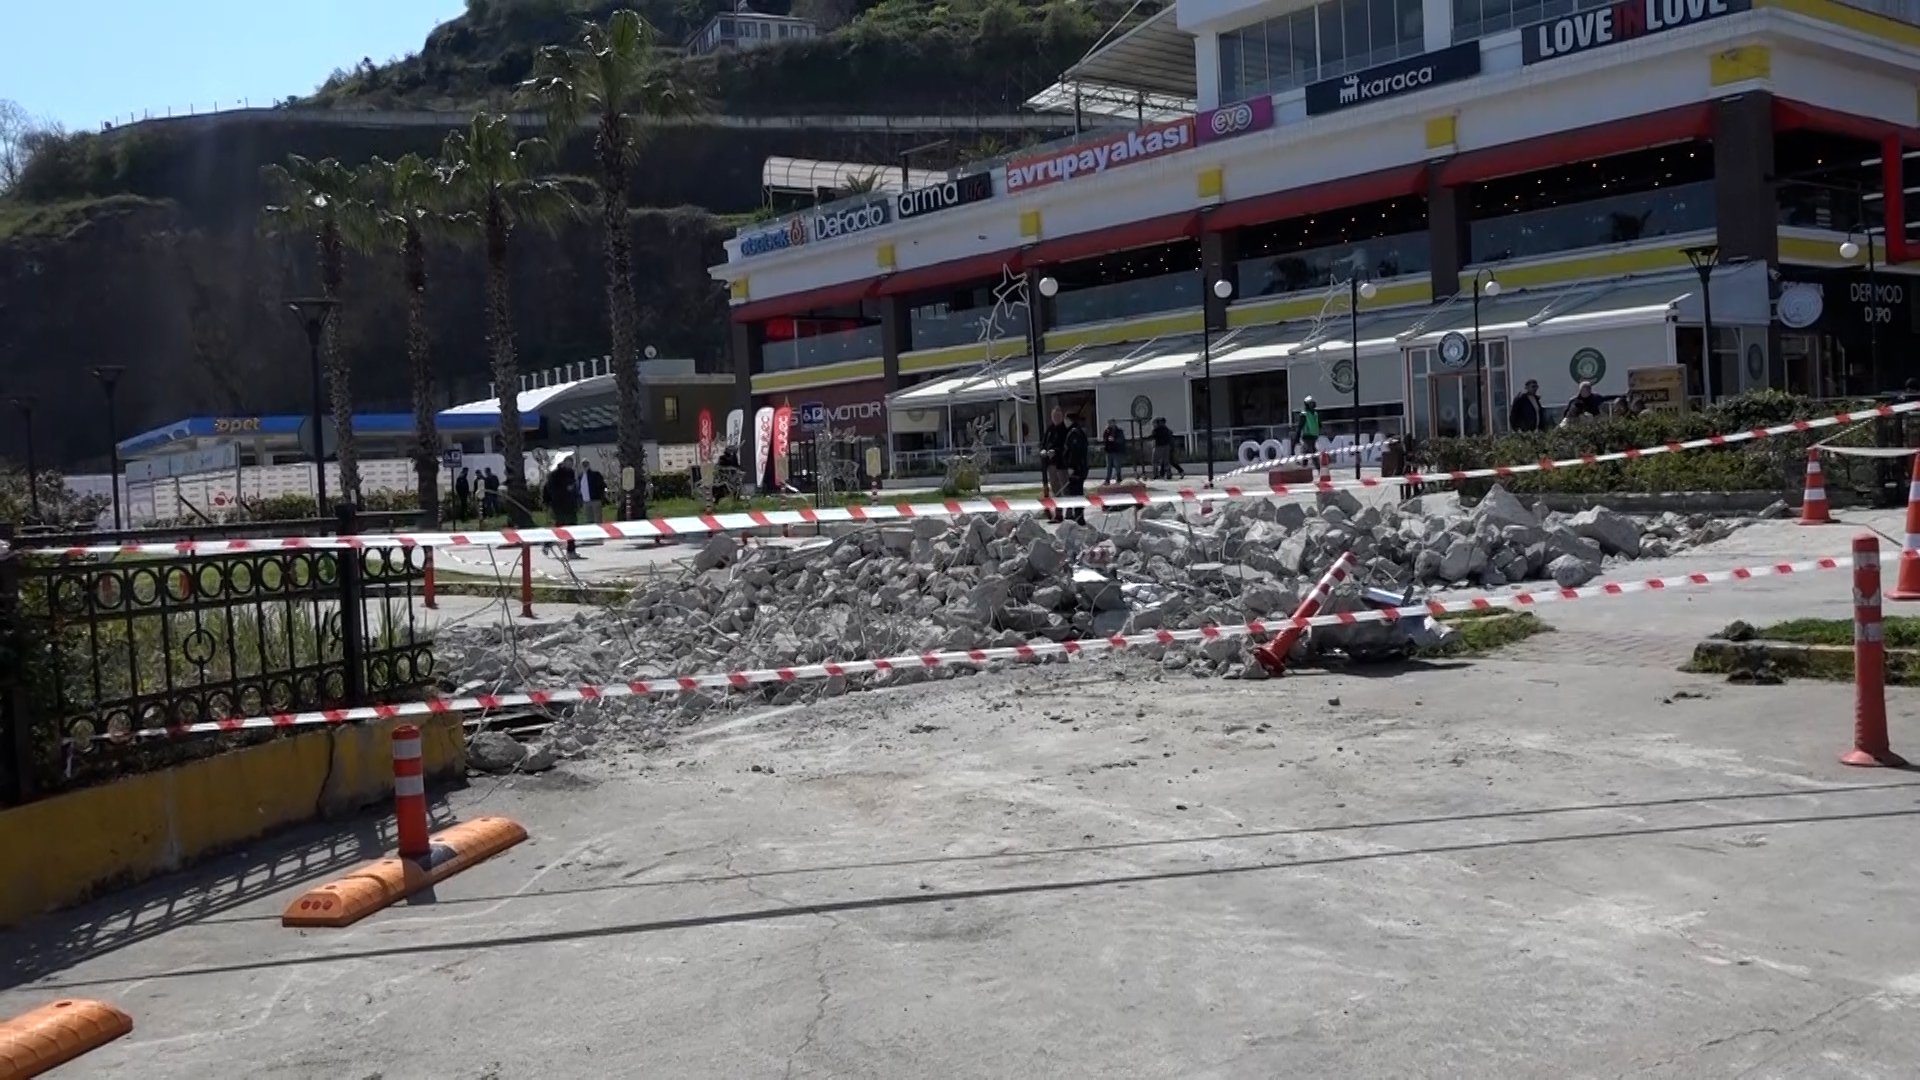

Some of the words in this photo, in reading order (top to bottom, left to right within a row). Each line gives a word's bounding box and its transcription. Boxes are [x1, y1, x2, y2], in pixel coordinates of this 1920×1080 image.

[1538, 7, 1613, 57] LOVE
[1361, 66, 1433, 98] karaca
[1212, 103, 1252, 134] eve
[1007, 124, 1189, 189] avrupayakası
[899, 181, 959, 216] arma
[816, 203, 885, 240] DeFacto
[215, 417, 261, 433] opet
[825, 400, 882, 422] MOTOR
[1238, 432, 1389, 468] COLMBIA
